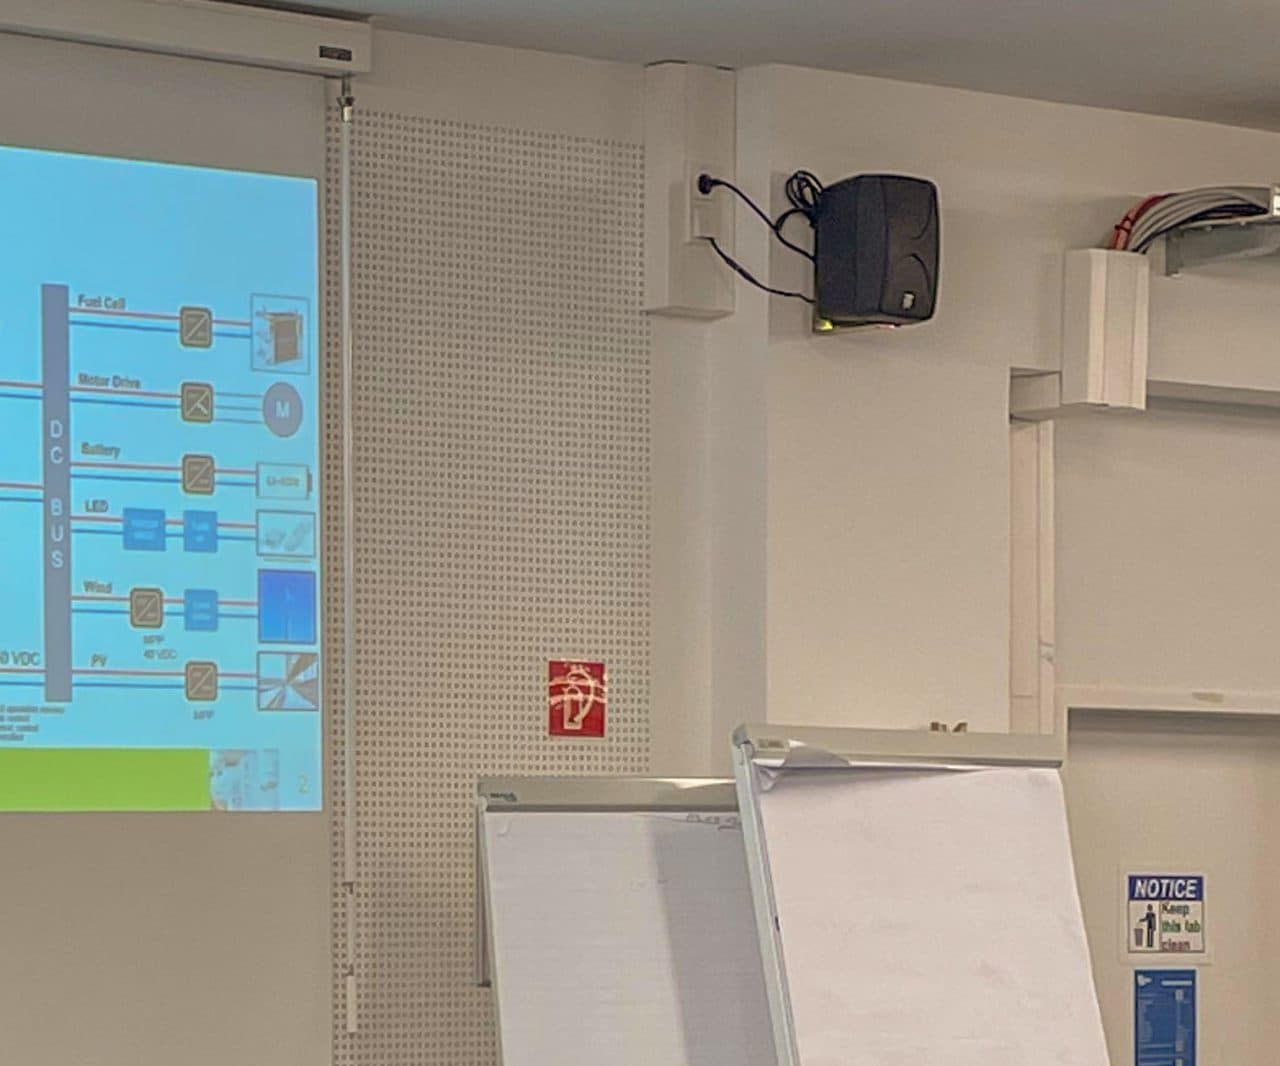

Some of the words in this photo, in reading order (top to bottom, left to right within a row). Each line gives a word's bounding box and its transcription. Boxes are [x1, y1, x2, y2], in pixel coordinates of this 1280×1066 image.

[78, 372, 108, 388] Motor
[111, 375, 141, 390] Drive
[275, 400, 290, 419] M
[81, 442, 121, 460] Battery
[84, 500, 109, 514] LED
[84, 579, 113, 595] Wind
[10, 650, 41, 667] VDC
[1134, 879, 1197, 898] NOTICE
[1162, 903, 1190, 917] Keep
[1161, 920, 1181, 933] this
[1185, 920, 1201, 933] lab
[1161, 939, 1191, 950] clean
